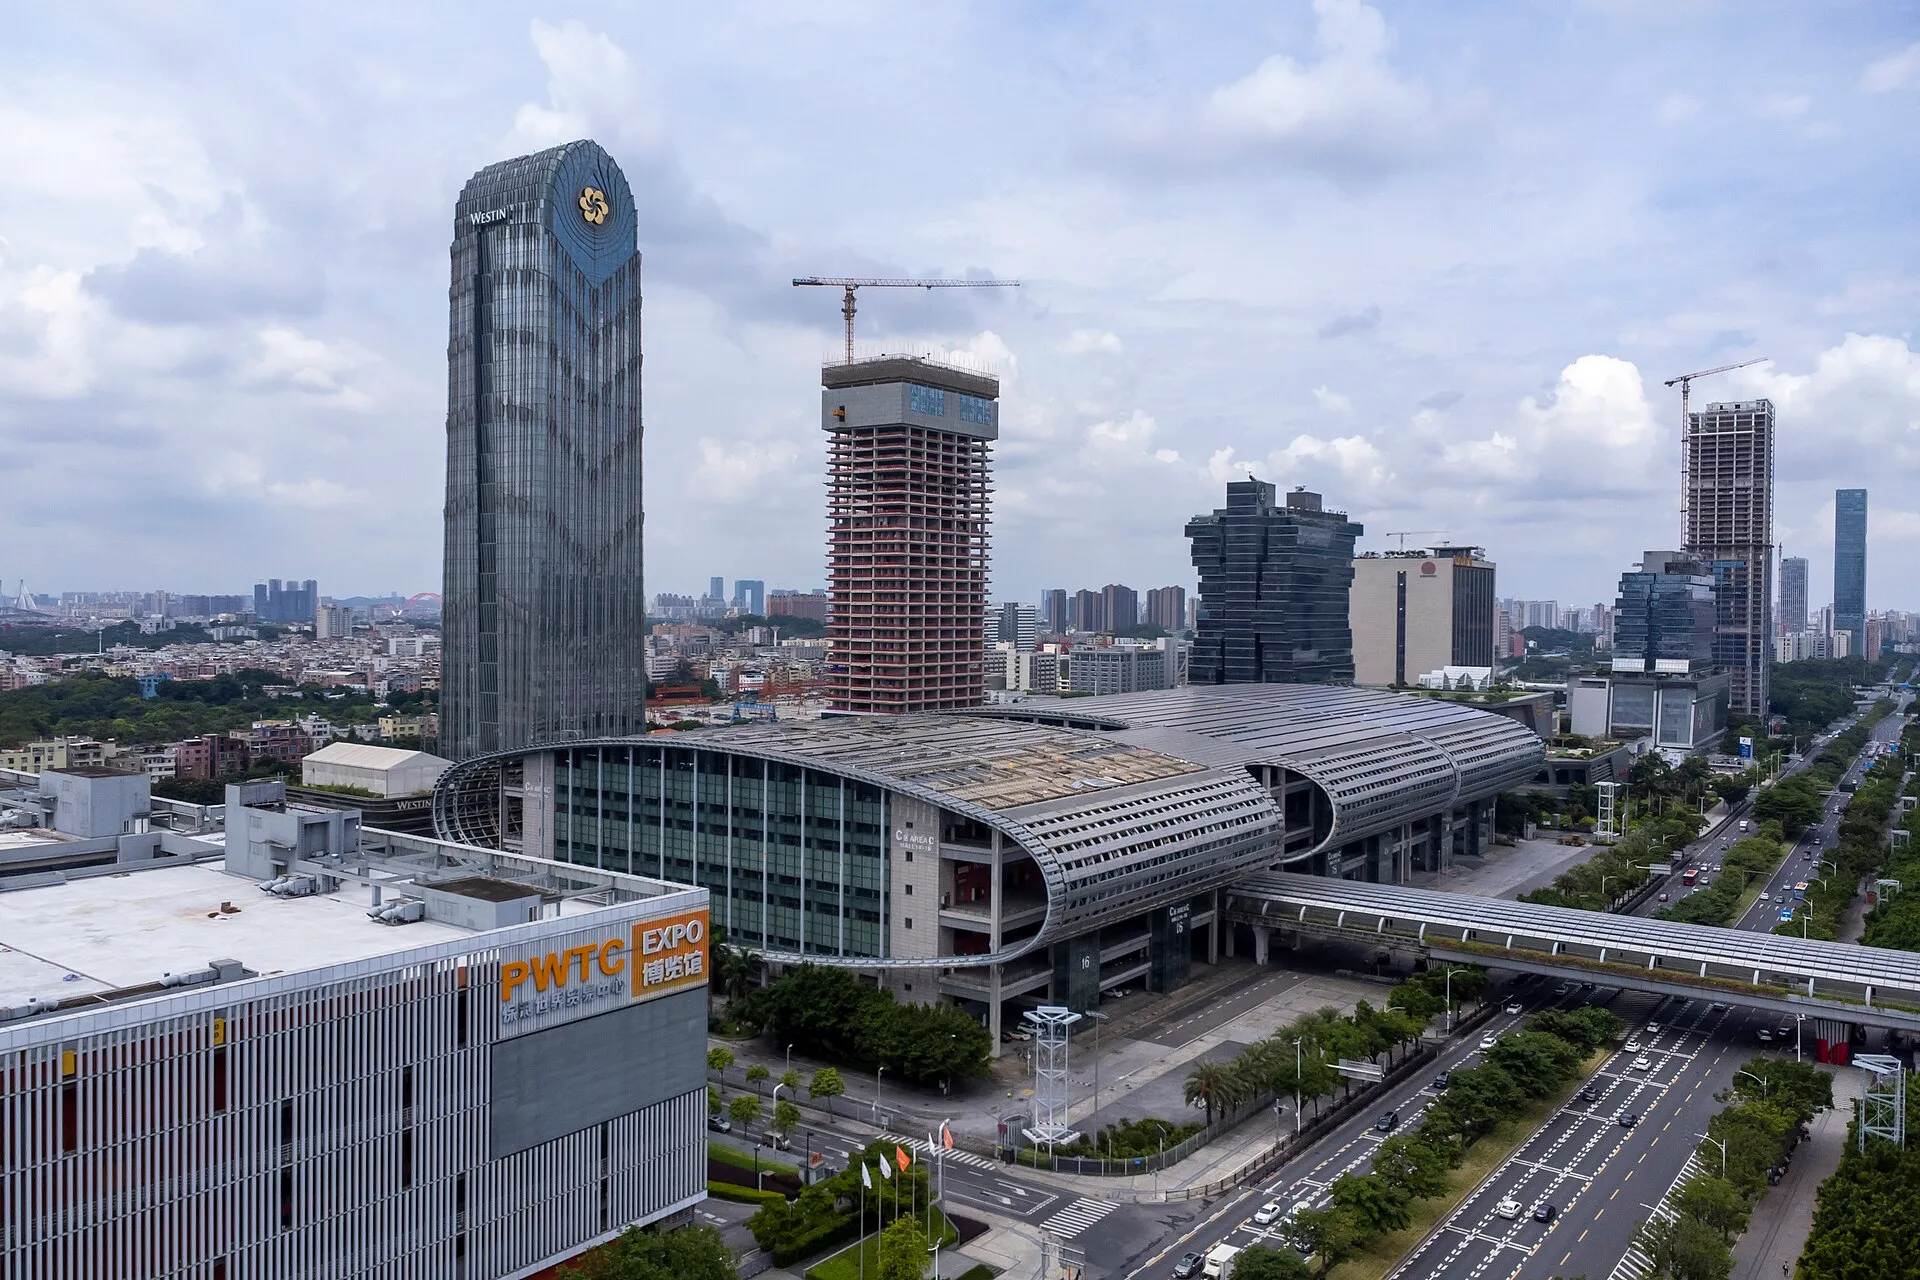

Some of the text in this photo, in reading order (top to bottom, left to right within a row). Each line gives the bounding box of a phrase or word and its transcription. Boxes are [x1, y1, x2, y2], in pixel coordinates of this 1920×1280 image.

[470, 207, 506, 226] WESTIN
[396, 800, 432, 810] WESTIN
[909, 835, 928, 845] AREA
[928, 836, 935, 845] C
[642, 919, 704, 956] EXPO
[501, 937, 625, 1003] PWTC
[642, 950, 703, 987] 博览馆
[1081, 955, 1090, 970] 16
